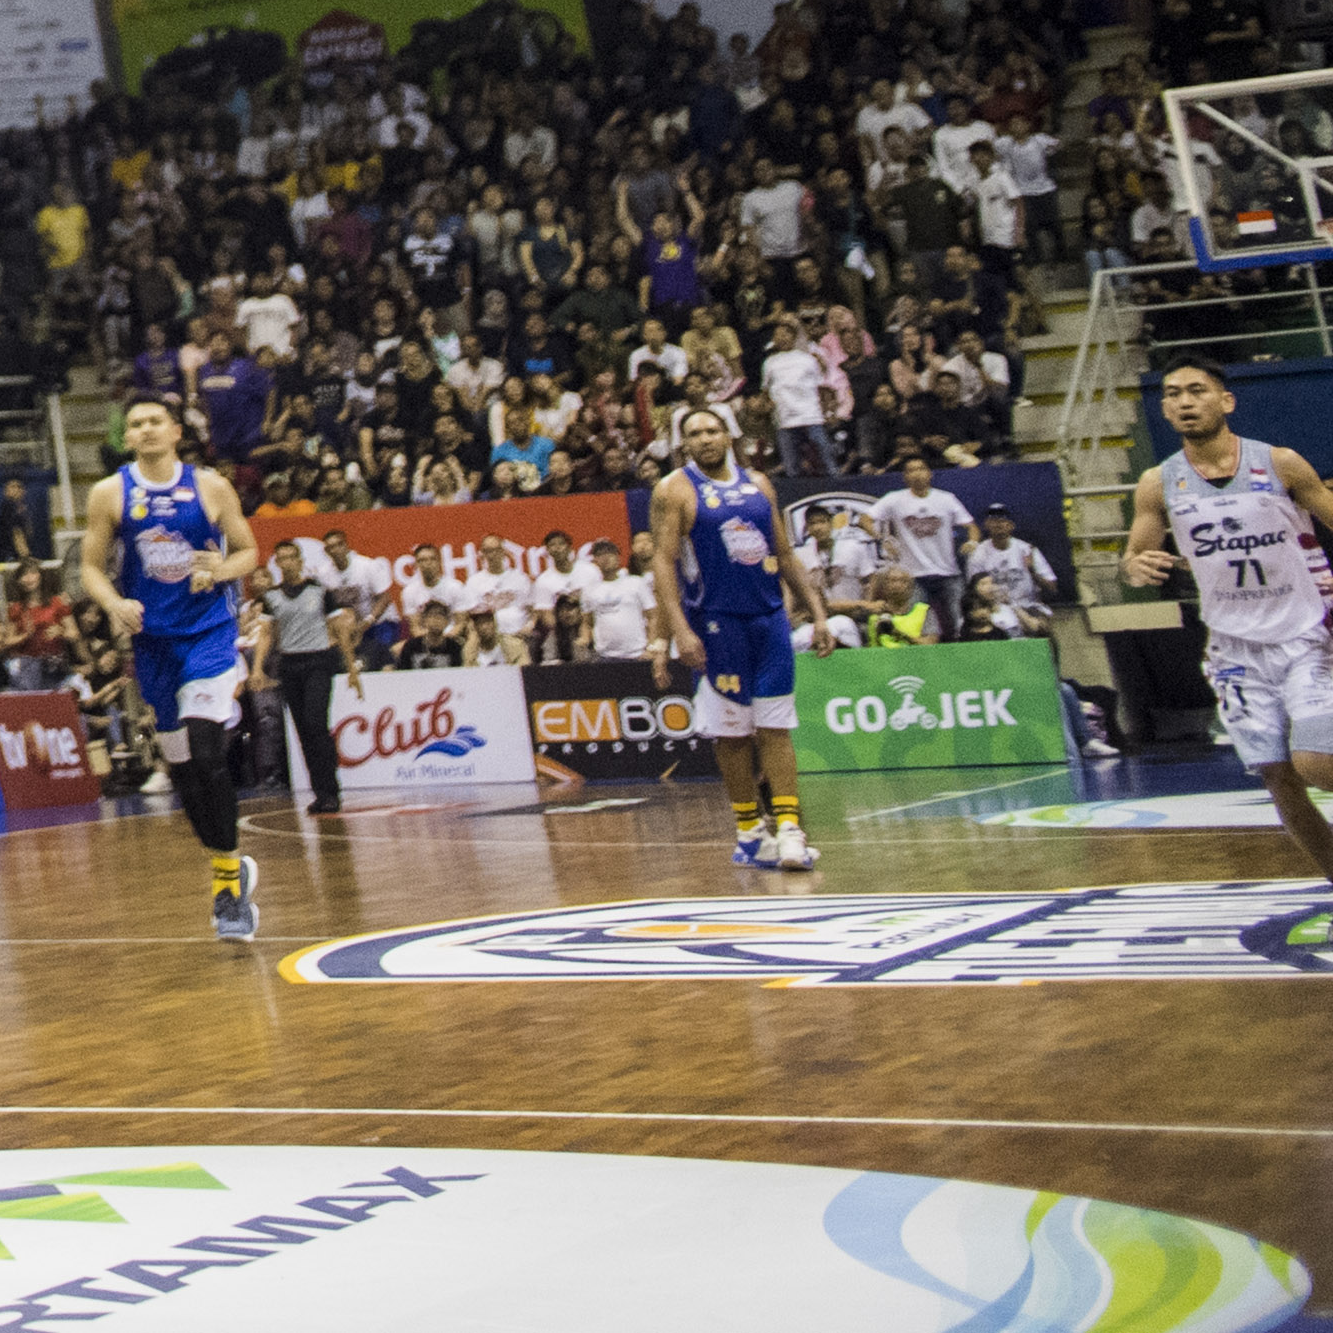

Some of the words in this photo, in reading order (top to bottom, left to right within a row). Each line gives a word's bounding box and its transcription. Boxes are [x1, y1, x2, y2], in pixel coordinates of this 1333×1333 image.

[1190, 522, 1287, 558] Stapac
[1228, 558, 1267, 588] 71
[332, 686, 455, 769] Club
[825, 695, 890, 735] GO
[938, 689, 1018, 729] JEK
